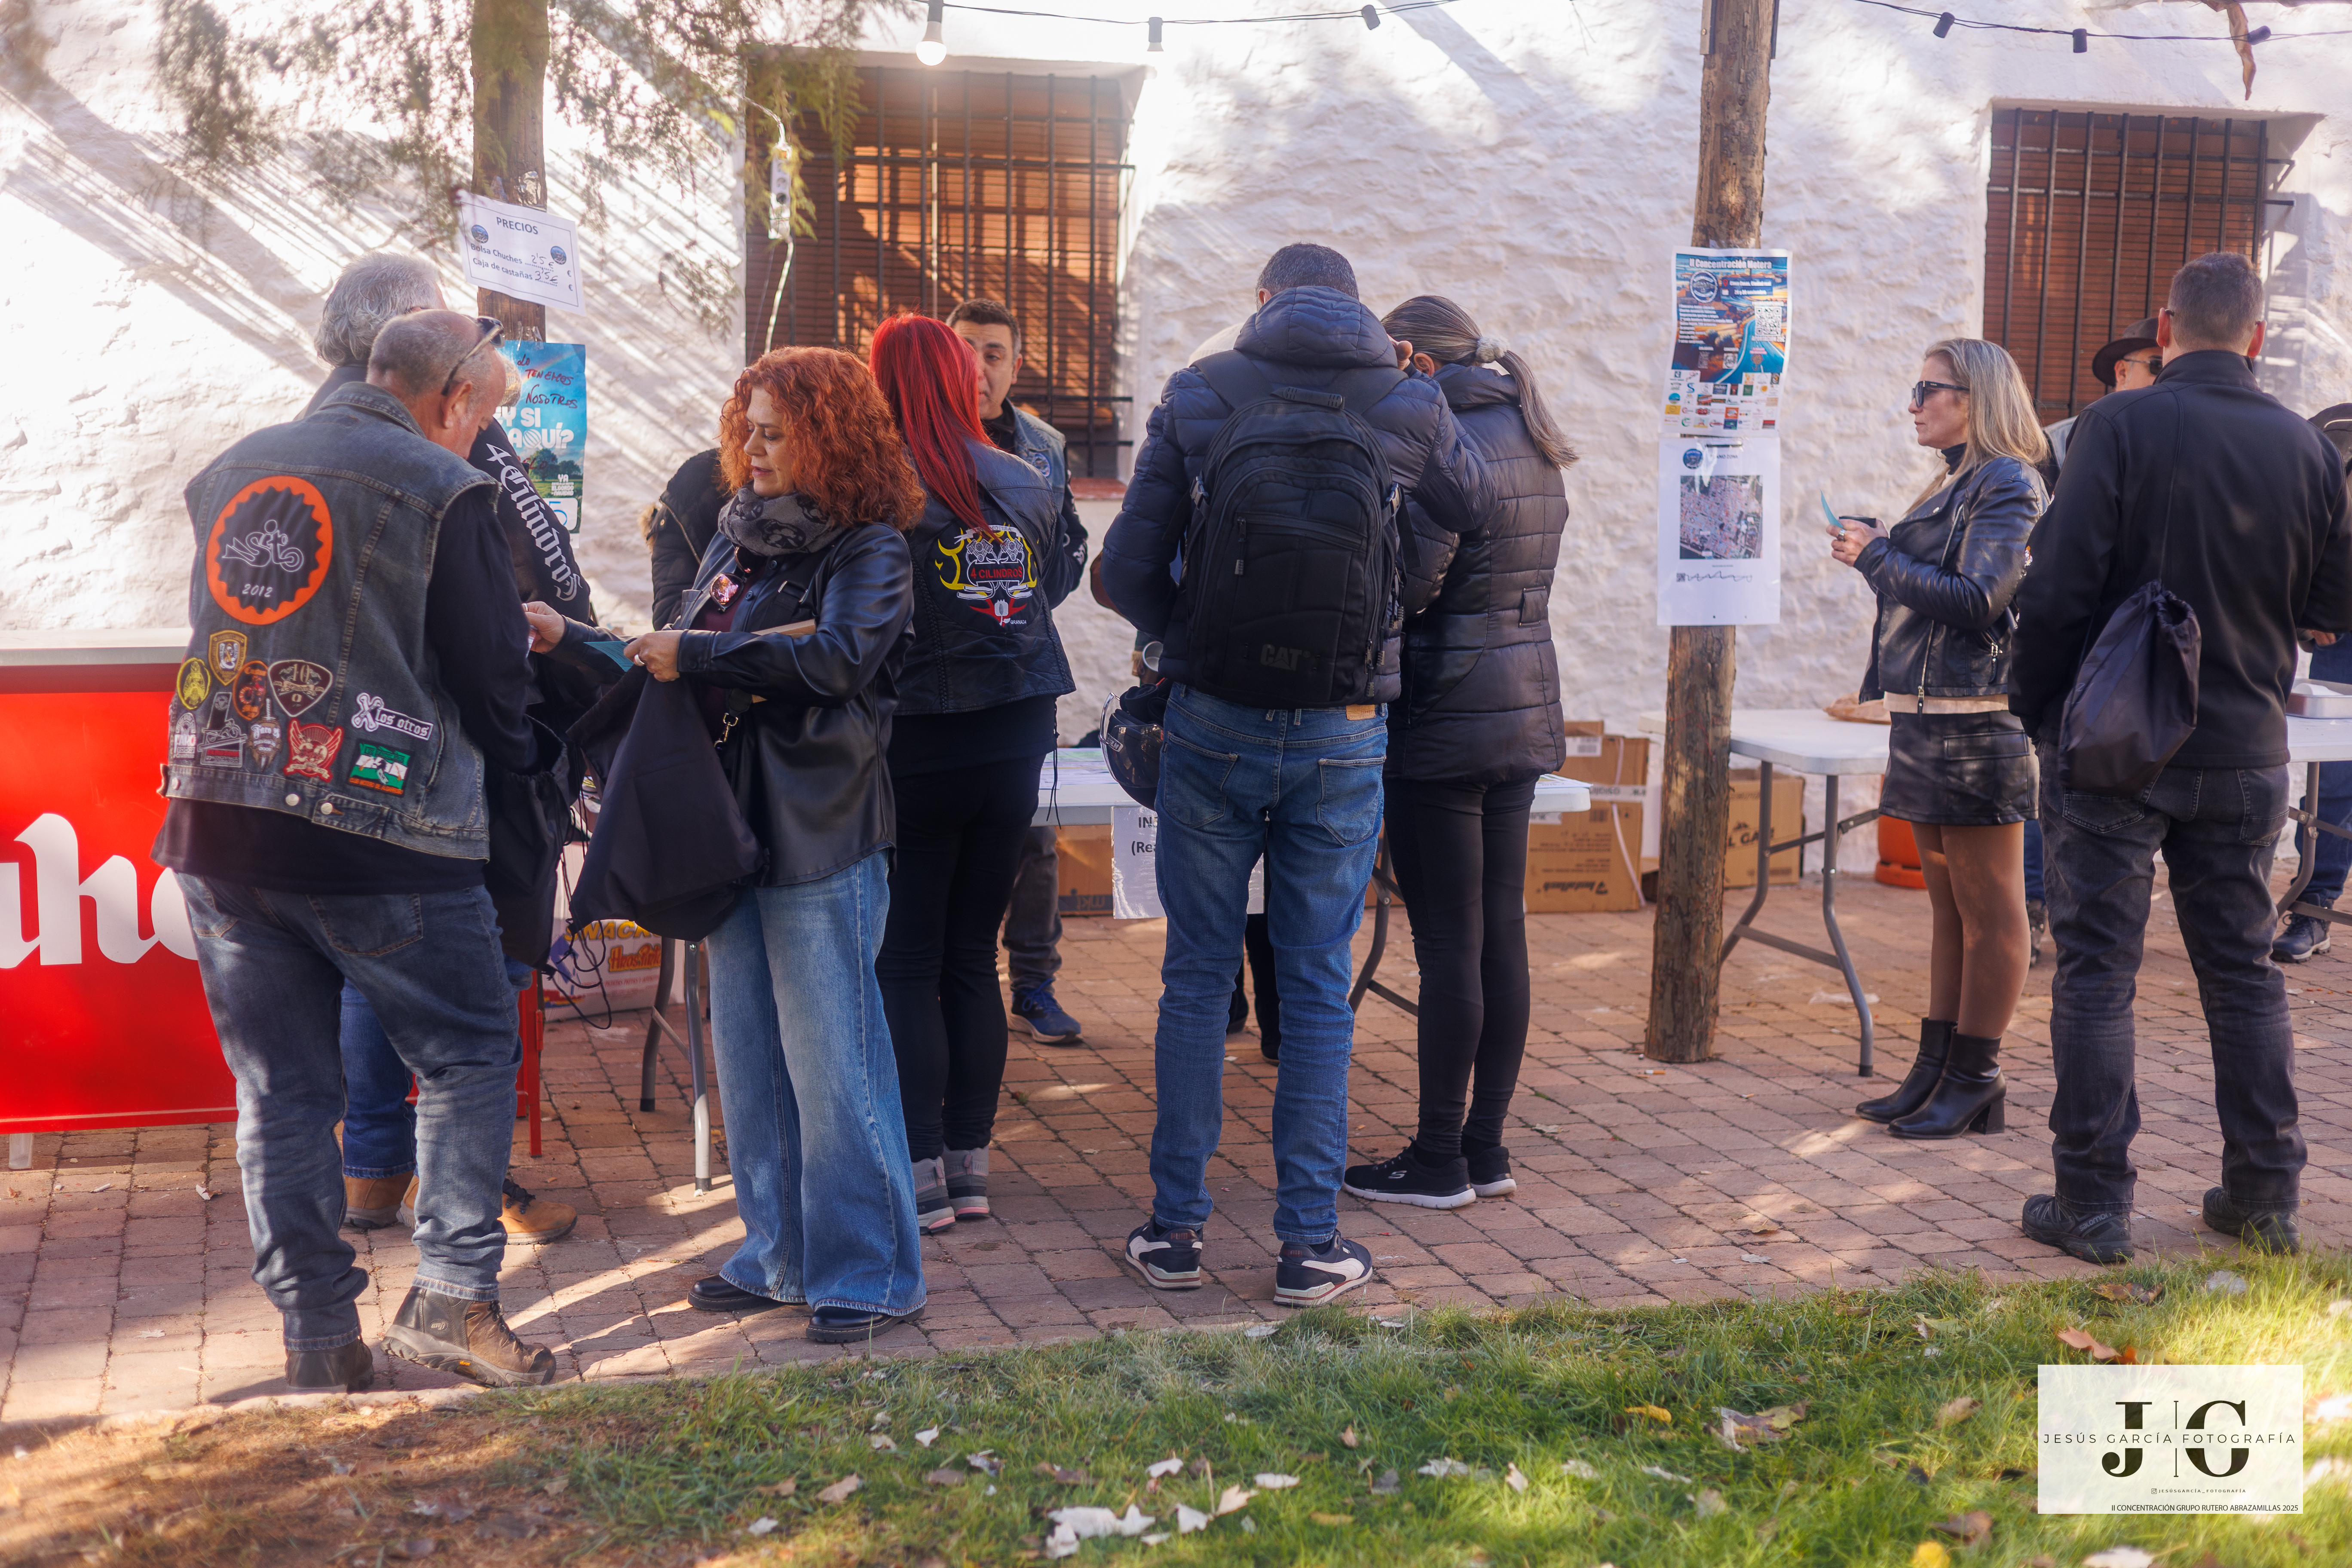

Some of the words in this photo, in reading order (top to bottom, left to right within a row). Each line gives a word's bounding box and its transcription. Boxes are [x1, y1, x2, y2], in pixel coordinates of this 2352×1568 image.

[496, 217, 538, 234] PRECIOS
[471, 243, 491, 254] Bolsa
[493, 250, 522, 264] Chuches
[1695, 258, 1746, 269] Concentración
[1747, 260, 1772, 269] Motera
[473, 258, 489, 268] Caja
[491, 262, 500, 270] de
[502, 267, 533, 280] castañas
[525, 369, 574, 385] TENEMOS
[526, 384, 578, 409] NOSOTROS
[521, 407, 541, 427] SI
[508, 422, 574, 450] AQUÍ?
[558, 474, 569, 482] YA
[971, 568, 977, 579] 4
[979, 566, 1023, 579] CILINDROS
[242, 583, 273, 598] 2012
[375, 709, 395, 725] los
[397, 718, 429, 736] otros
[564, 921, 662, 941] SNACK
